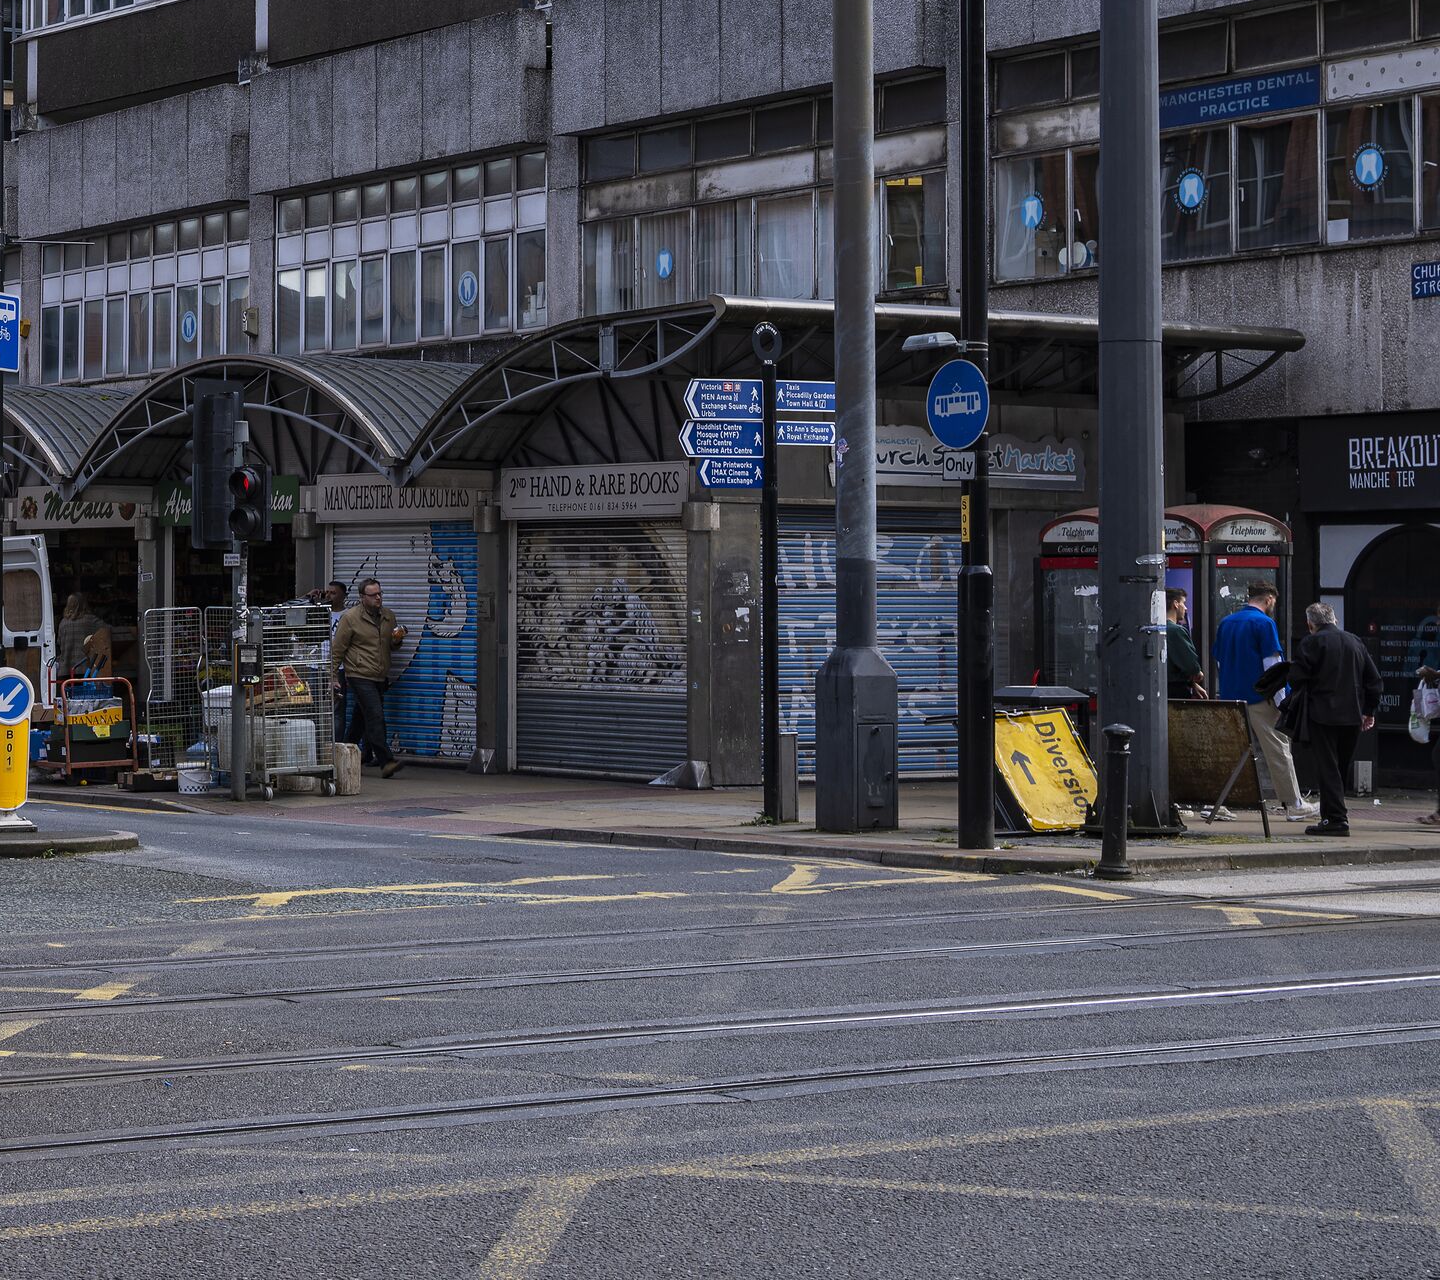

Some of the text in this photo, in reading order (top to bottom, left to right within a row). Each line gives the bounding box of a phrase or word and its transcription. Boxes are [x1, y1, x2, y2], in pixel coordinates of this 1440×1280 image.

[1160, 71, 1315, 107] MANCHESTER DENTAL
[1200, 95, 1270, 117] PRACTICE
[756, 324, 778, 335] High Street
[701, 393, 733, 401] MEN Arena
[786, 391, 836, 400] Piccadilly Gardens
[701, 402, 748, 411] Exchange Square
[696, 423, 742, 431] Buddhist Centre
[786, 425, 829, 434] St Ann's Square
[696, 431, 740, 439] Mosque (MYF)
[786, 433, 829, 441] Royal Exchange
[696, 438, 712, 446] Craft
[696, 446, 719, 454] Chinese
[1005, 443, 1076, 473] Market
[946, 457, 974, 475] Only
[530, 475, 572, 498] HAND
[575, 478, 585, 496] &
[588, 473, 626, 496] RARE
[629, 471, 680, 495] BOOKS
[727, 477, 753, 485] Exchange
[324, 484, 469, 511] MANCHESTER BOOKBUYERS
[43, 490, 114, 524] McCalls
[164, 488, 294, 523] Afro ian
[548, 502, 637, 512] TELEPHONE 0161 834 5964
[1061, 527, 1095, 537] Telephone
[1229, 525, 1266, 537] Telephone
[1057, 544, 1074, 553] Coins
[1080, 544, 1098, 554] Cards
[1226, 544, 1271, 554] Coins & Cards
[71, 713, 121, 726] BANANAS
